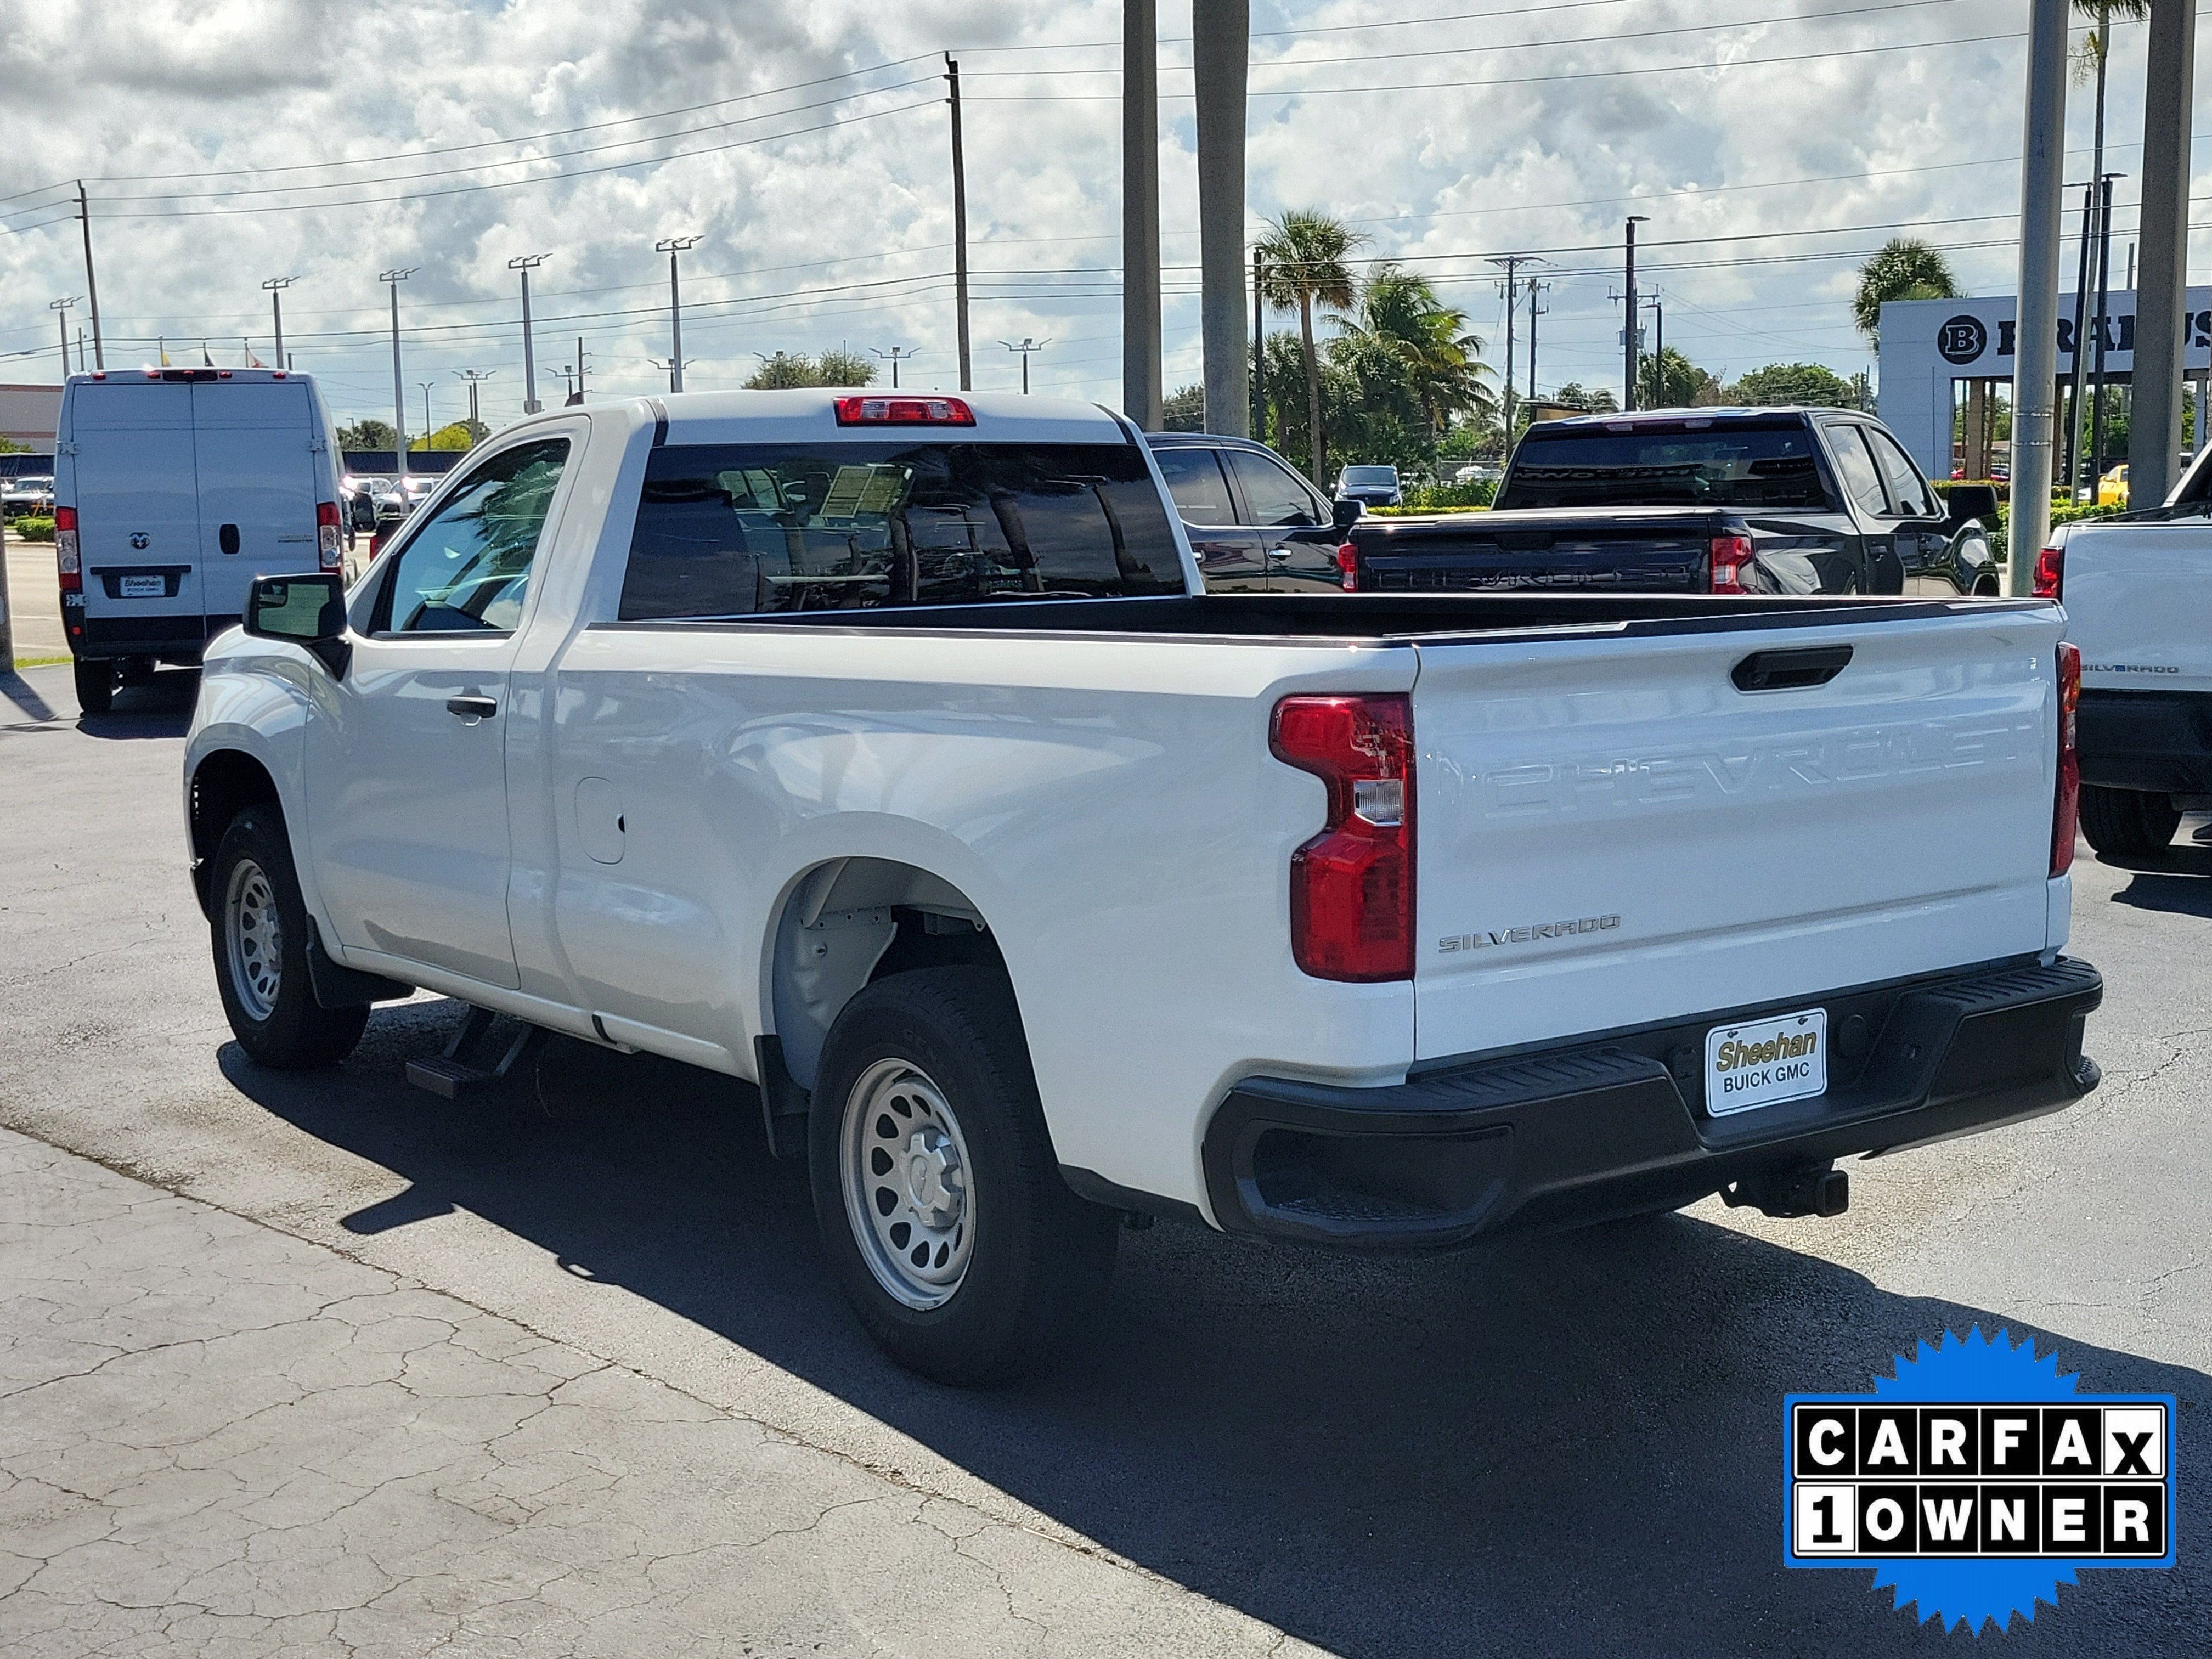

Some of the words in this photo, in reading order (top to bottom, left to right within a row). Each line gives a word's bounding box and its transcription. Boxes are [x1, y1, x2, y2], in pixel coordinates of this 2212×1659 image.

[1945, 325, 1980, 355] B
[1485, 723, 2033, 818] CHEVROLET
[1438, 913, 1622, 953] SILVERADO
[1716, 1032, 1817, 1072] Sheehan
[1724, 1069, 1771, 1093] BUICK
[1776, 1062, 1810, 1081] GMC
